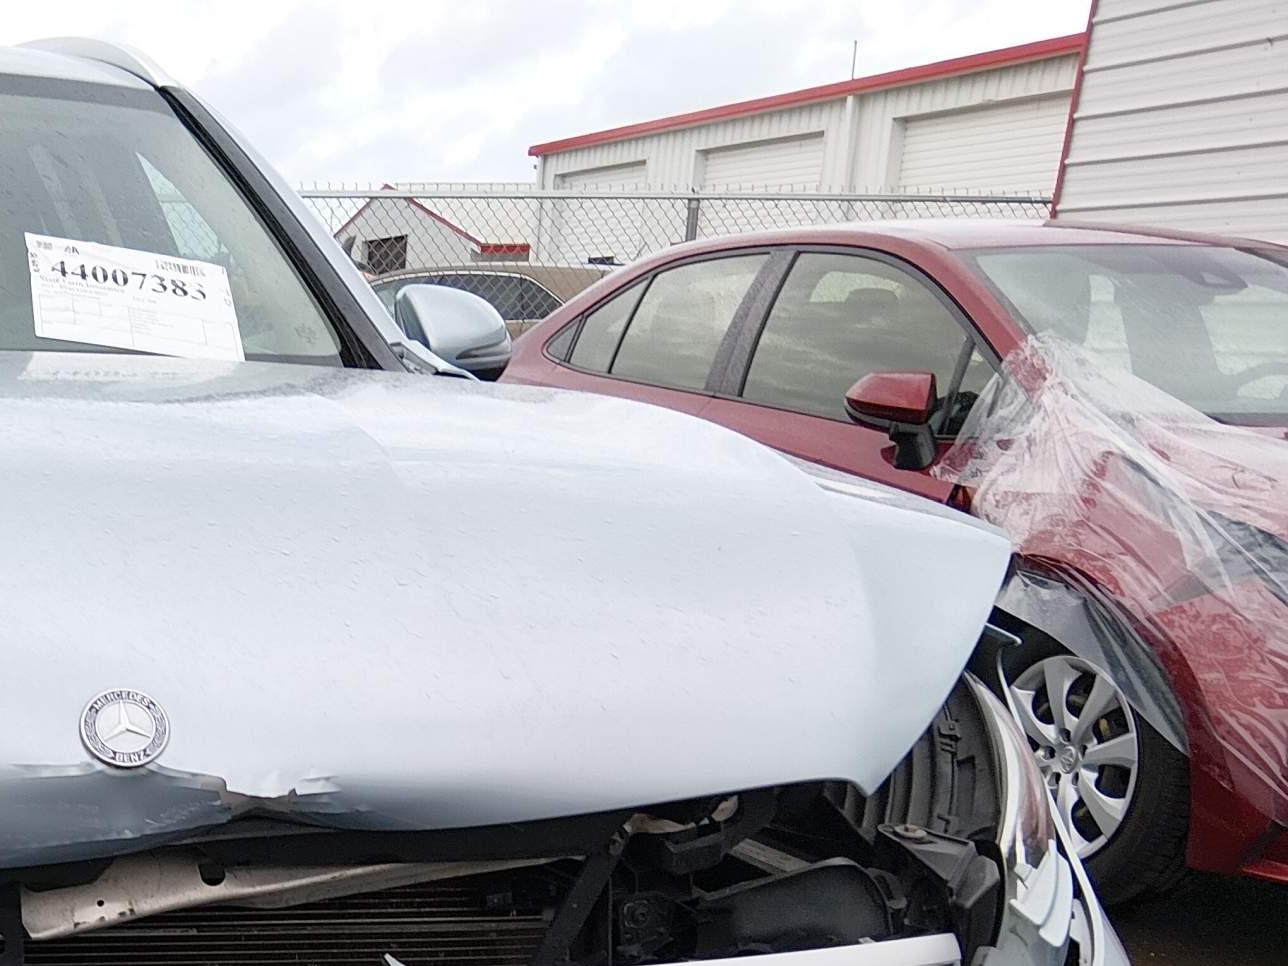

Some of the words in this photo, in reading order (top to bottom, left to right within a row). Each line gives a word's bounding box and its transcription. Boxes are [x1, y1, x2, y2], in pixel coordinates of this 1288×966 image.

[50, 259, 207, 301] 44007383
[92, 690, 152, 711] MERCEDES
[115, 751, 145, 763] BENZ
